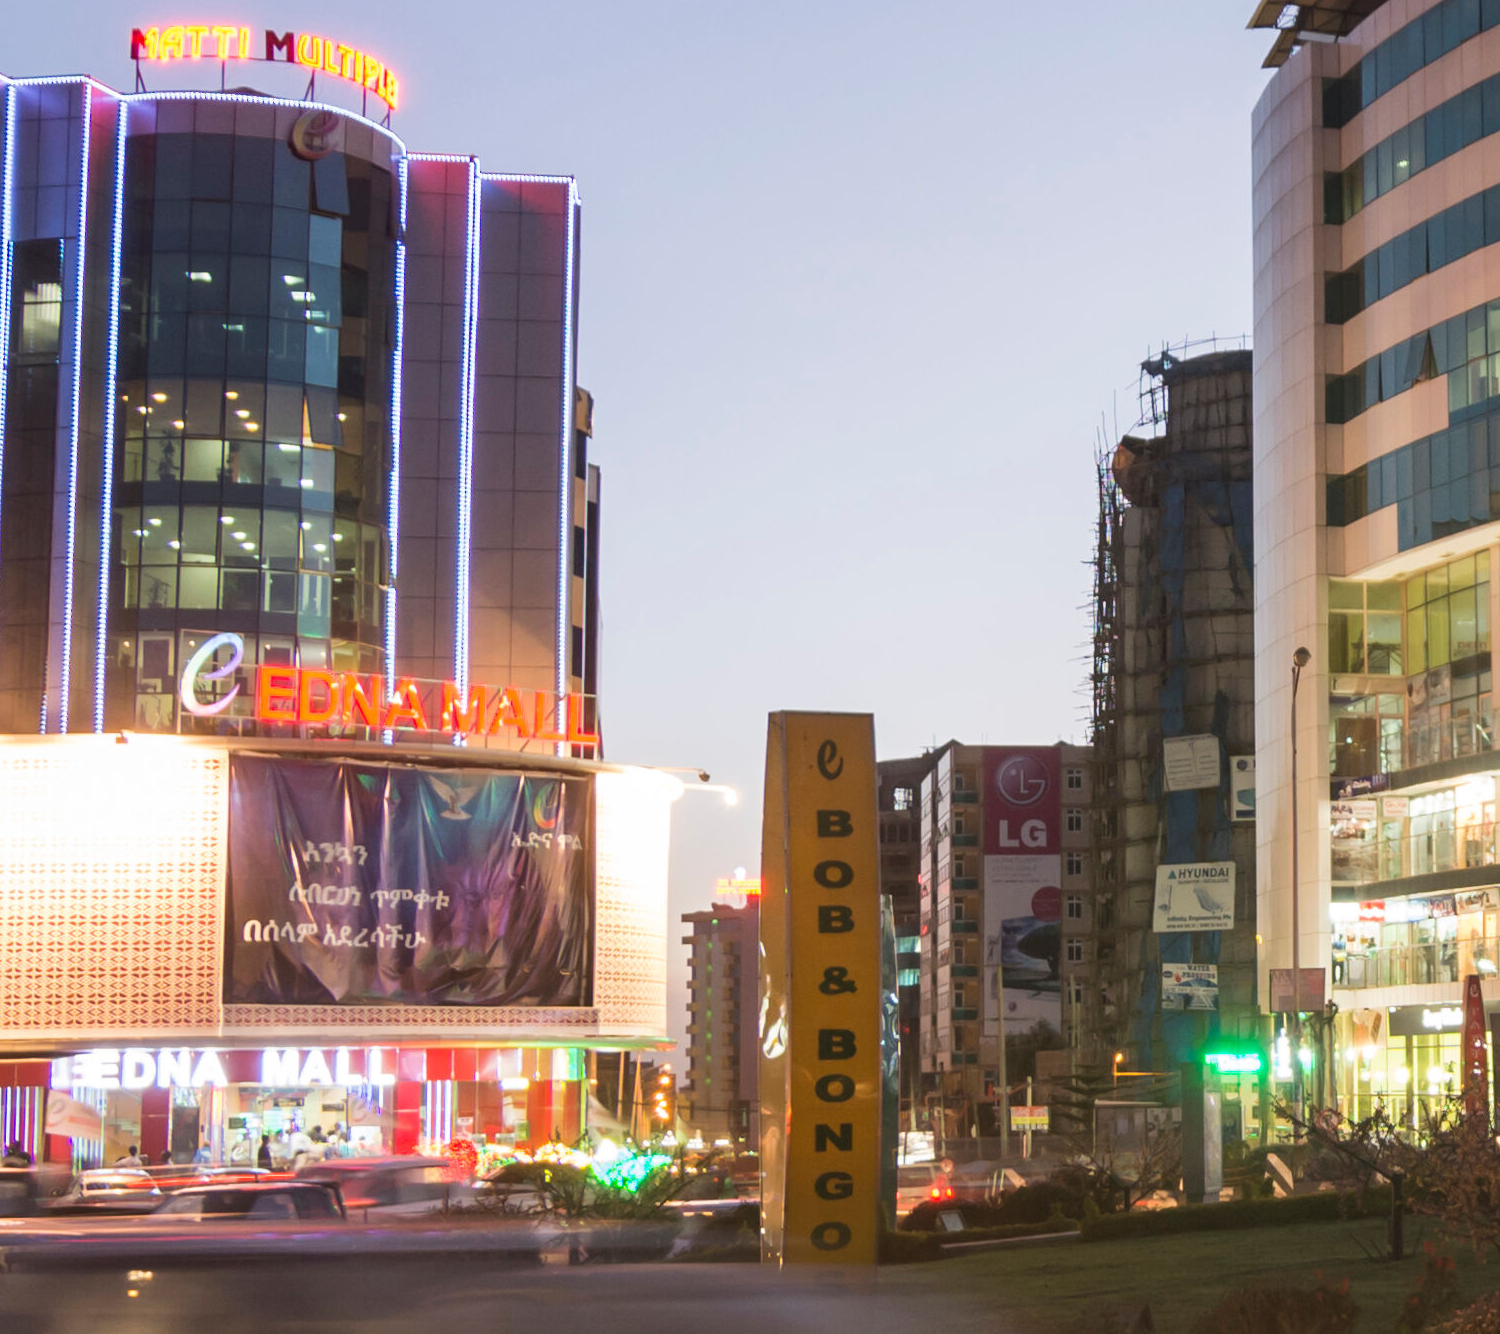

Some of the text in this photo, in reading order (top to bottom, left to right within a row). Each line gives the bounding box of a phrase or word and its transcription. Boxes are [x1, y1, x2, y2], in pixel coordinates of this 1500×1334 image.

[131, 25, 250, 60] MATTI
[257, 664, 600, 744] EDNA MALL
[998, 818, 1048, 848] LG
[814, 809, 855, 935] BOB
[1178, 867, 1229, 879] HYUNDAI
[818, 966, 858, 997] &
[88, 1046, 396, 1088] EDNA MALL
[810, 1028, 858, 1252] BONGO
